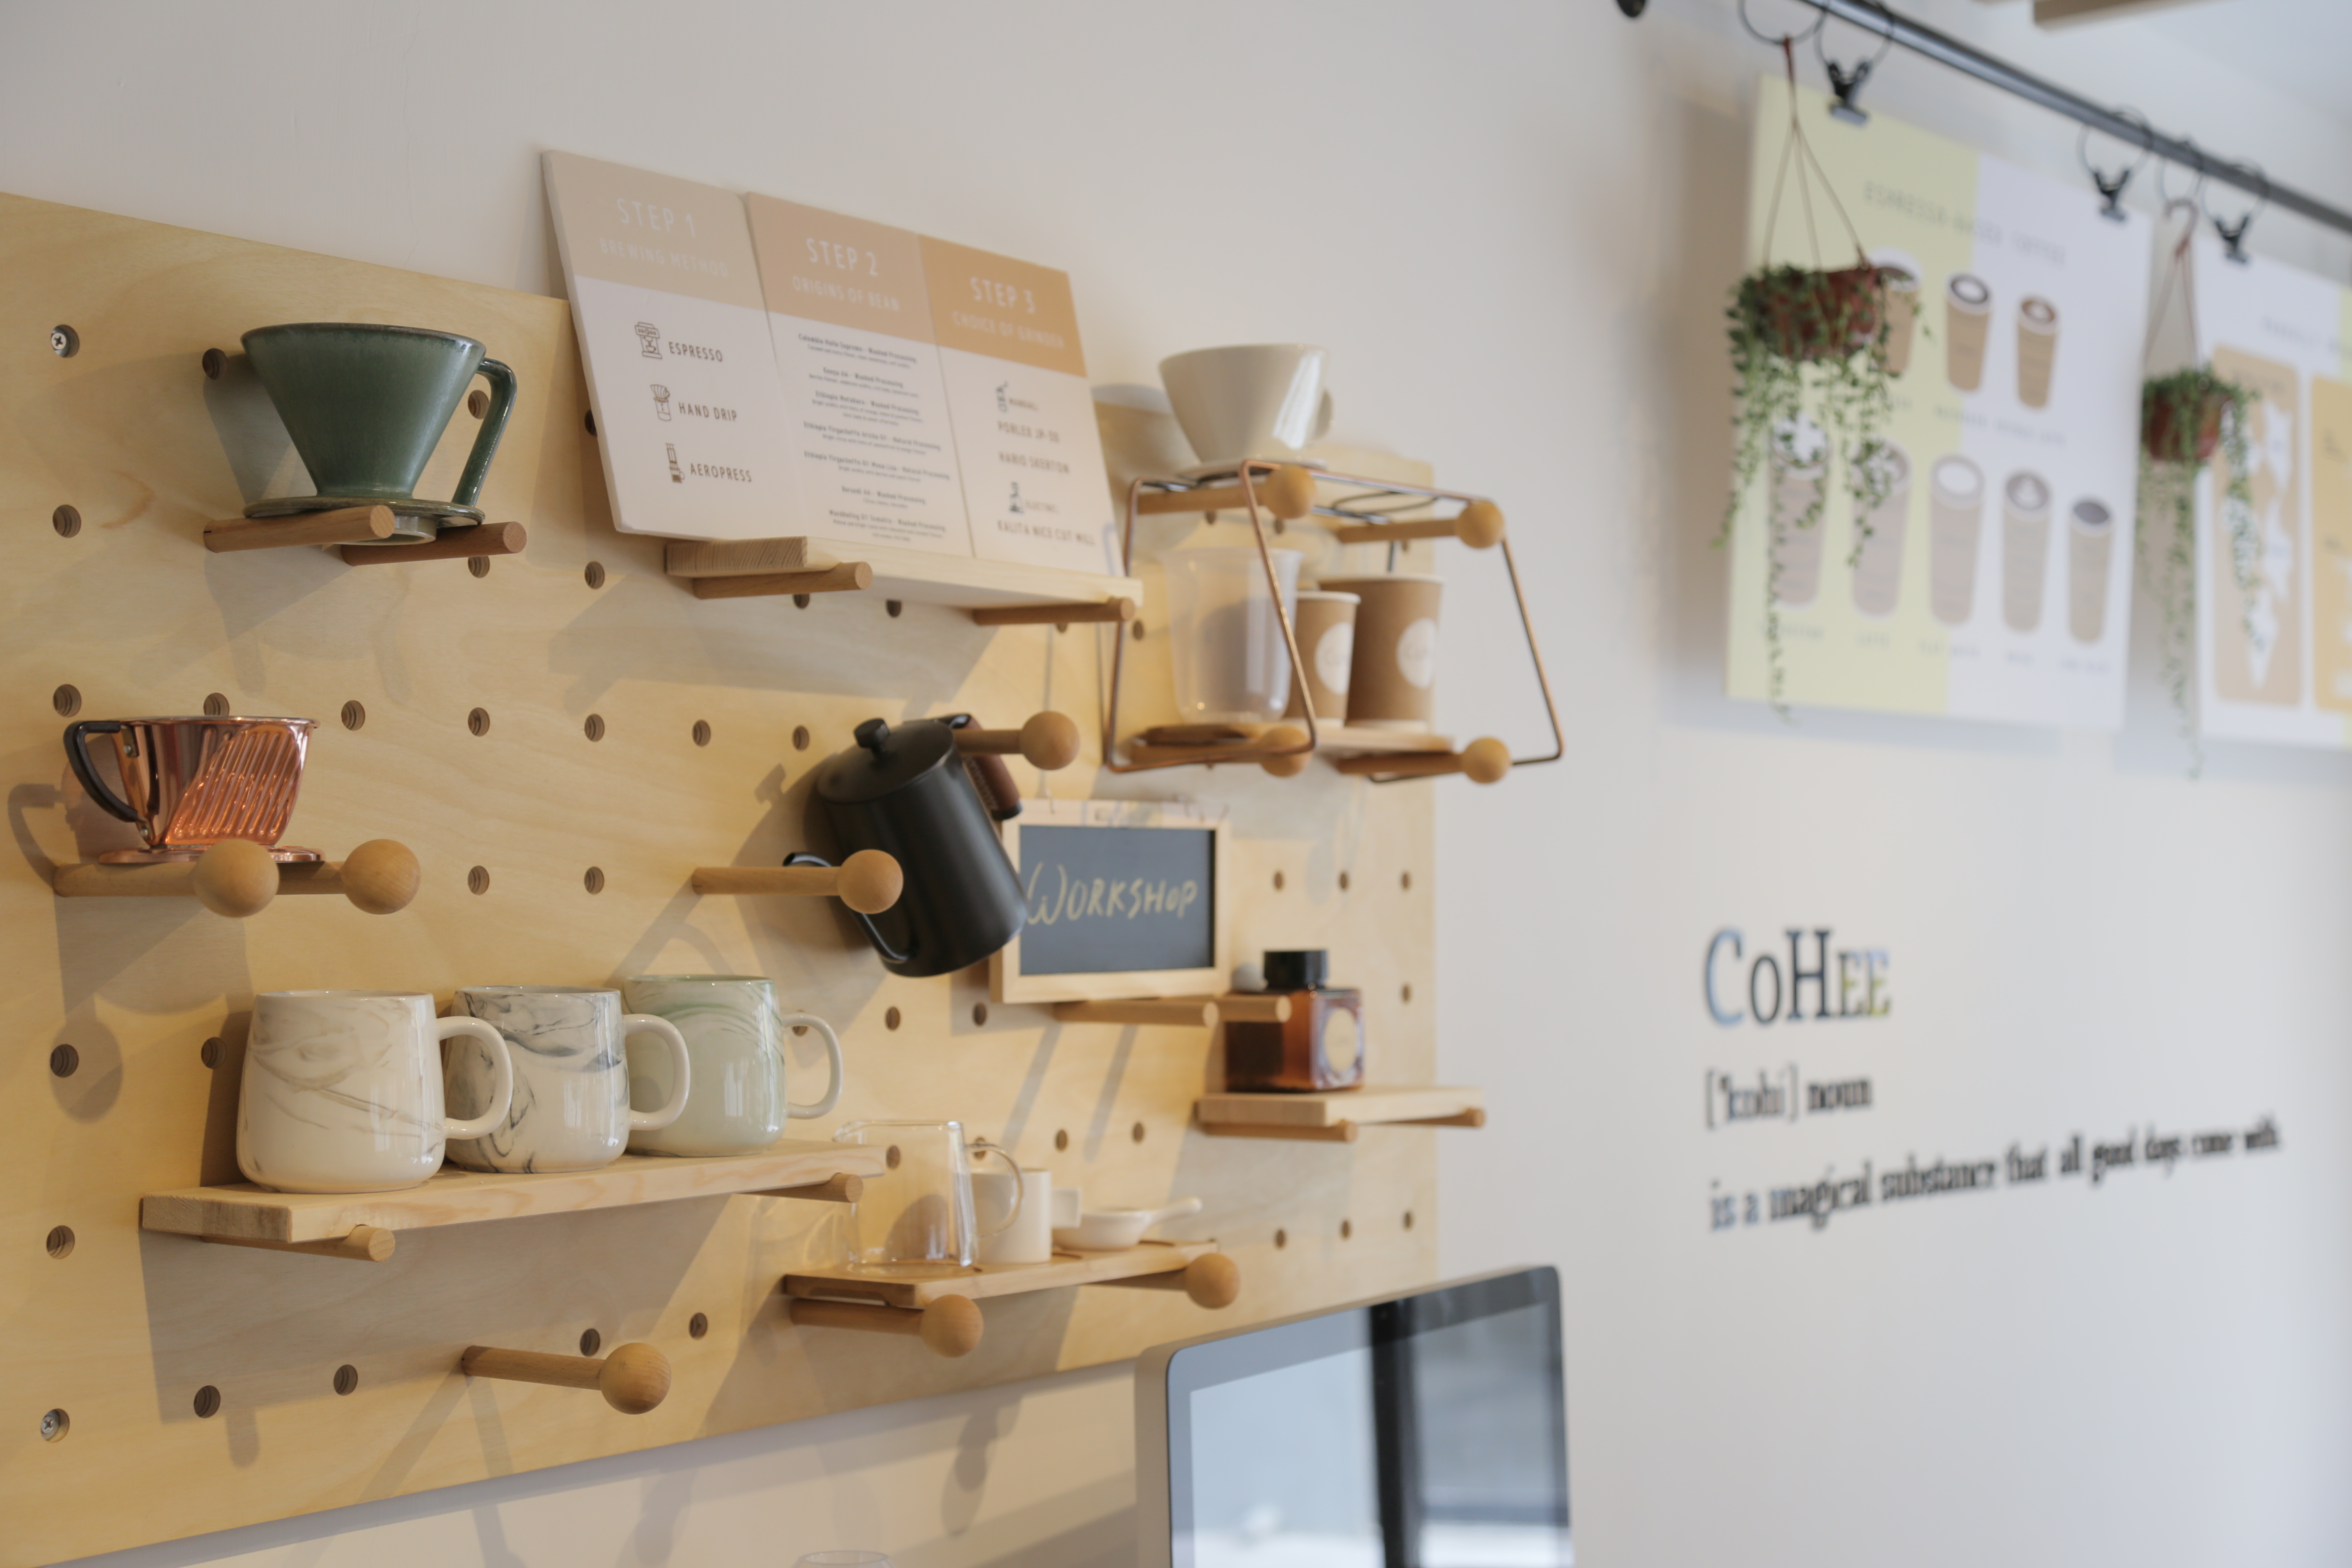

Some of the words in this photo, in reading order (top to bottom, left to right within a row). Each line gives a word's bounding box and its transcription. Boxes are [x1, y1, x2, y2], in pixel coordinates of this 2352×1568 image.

[616, 198, 675, 233] STEP
[685, 212, 696, 237] 1
[600, 238, 665, 265] BREWING
[670, 252, 728, 278] METHOD
[806, 237, 857, 272] STEP
[866, 251, 879, 276] 2
[792, 275, 845, 301] ORIGINS
[848, 288, 864, 304] OF
[867, 291, 900, 312] BEAN
[970, 276, 1018, 309] STEP
[1023, 288, 1036, 315] 3
[952, 310, 997, 335] CHOICE
[998, 321, 1014, 337] OF
[668, 341, 723, 362] ESPRESSO
[678, 401, 709, 418] HAND
[714, 406, 737, 422] DRIP
[690, 462, 752, 483] AEROPRESS
[997, 519, 1030, 535] KALITA
[1711, 1181, 1736, 1232] is
[1743, 1192, 1759, 1226] a
[1769, 1161, 1872, 1233] magical
[1880, 1152, 1997, 1202] substance
[2006, 1141, 2047, 1184] that
[2060, 1133, 2080, 1174] all
